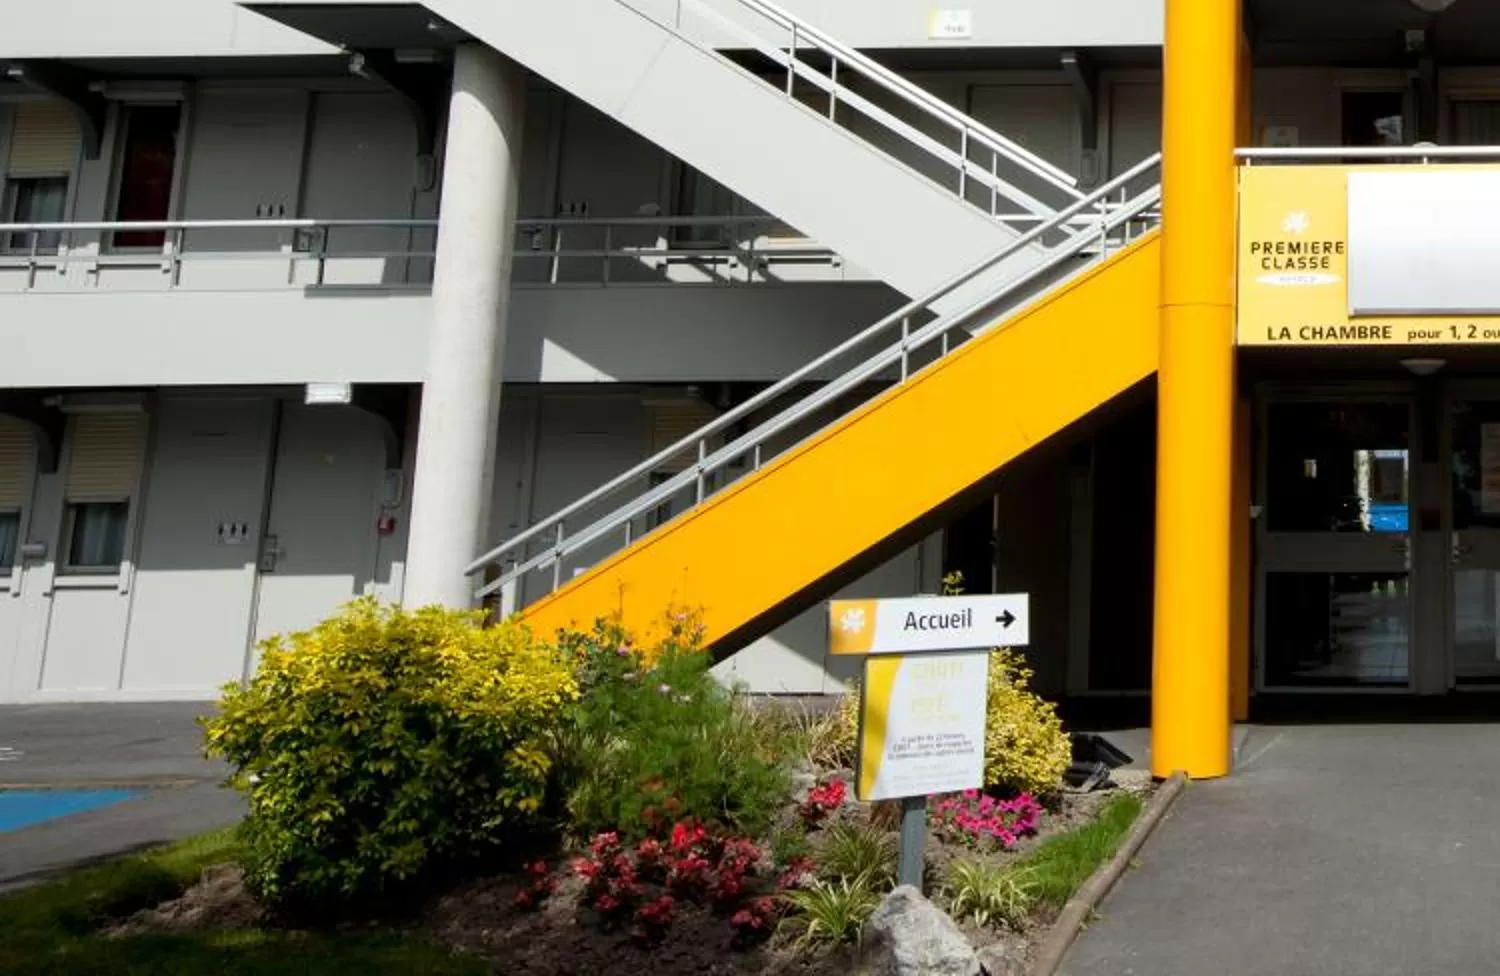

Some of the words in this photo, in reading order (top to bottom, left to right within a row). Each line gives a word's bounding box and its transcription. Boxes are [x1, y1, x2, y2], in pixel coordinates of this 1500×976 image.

[1251, 241, 1345, 255] PREMIERE
[1261, 256, 1330, 270] CLASSE
[1267, 326, 1291, 341] LA
[1299, 325, 1392, 341] CHAMBRE
[1407, 328, 1442, 341] pour
[1467, 324, 1477, 339] 2
[1483, 327, 1500, 339] ou
[904, 608, 973, 631] Accueil
